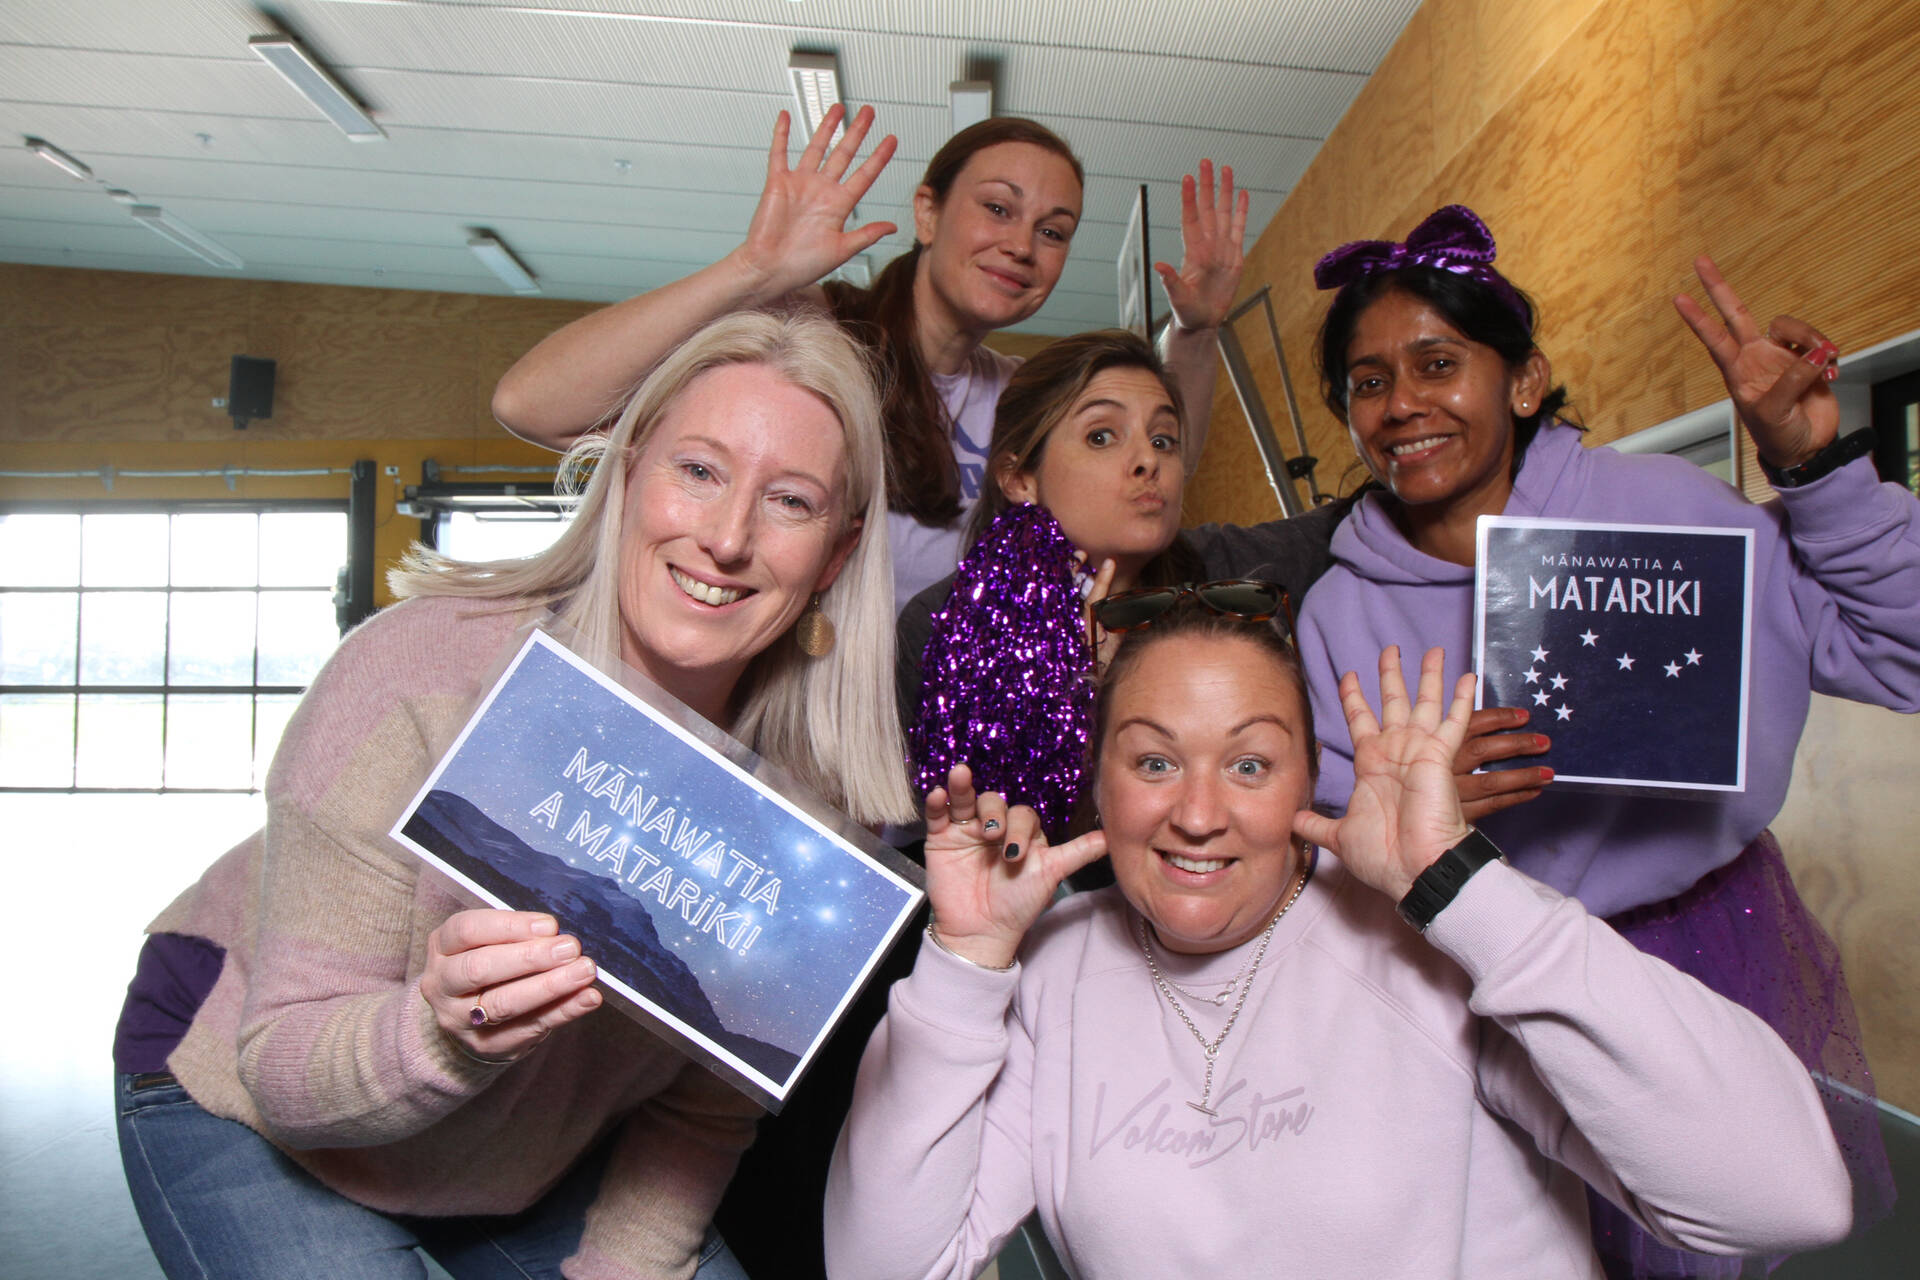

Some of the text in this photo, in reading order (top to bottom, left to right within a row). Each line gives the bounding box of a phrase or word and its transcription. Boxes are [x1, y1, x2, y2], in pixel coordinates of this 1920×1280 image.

[1542, 553, 1684, 571] MĀNAWATIA A
[1529, 575, 1701, 617] MATARIKI
[529, 791, 563, 829] A
